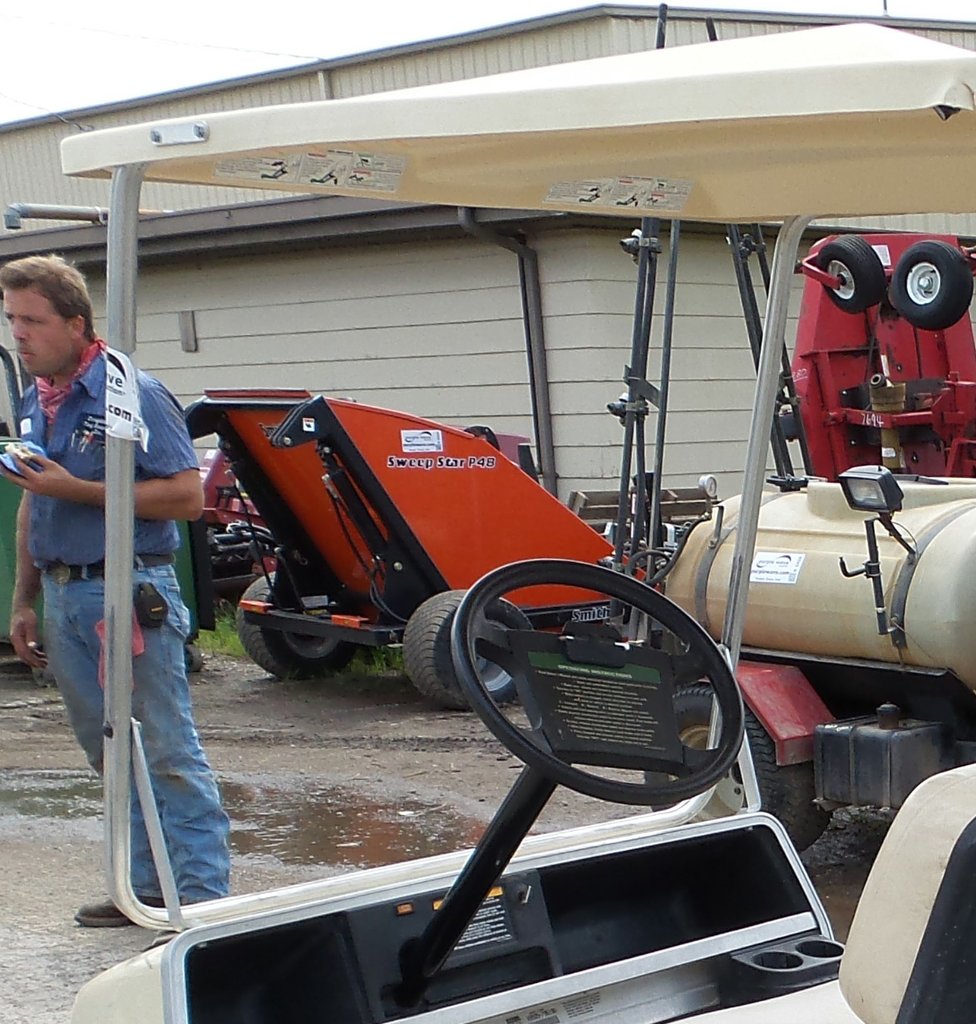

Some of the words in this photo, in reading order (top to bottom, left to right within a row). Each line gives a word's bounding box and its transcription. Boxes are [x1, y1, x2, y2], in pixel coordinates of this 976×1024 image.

[387, 455, 433, 470] Sweep
[436, 455, 465, 468] Star
[468, 456, 496, 468] P48
[571, 605, 609, 622] Smith
